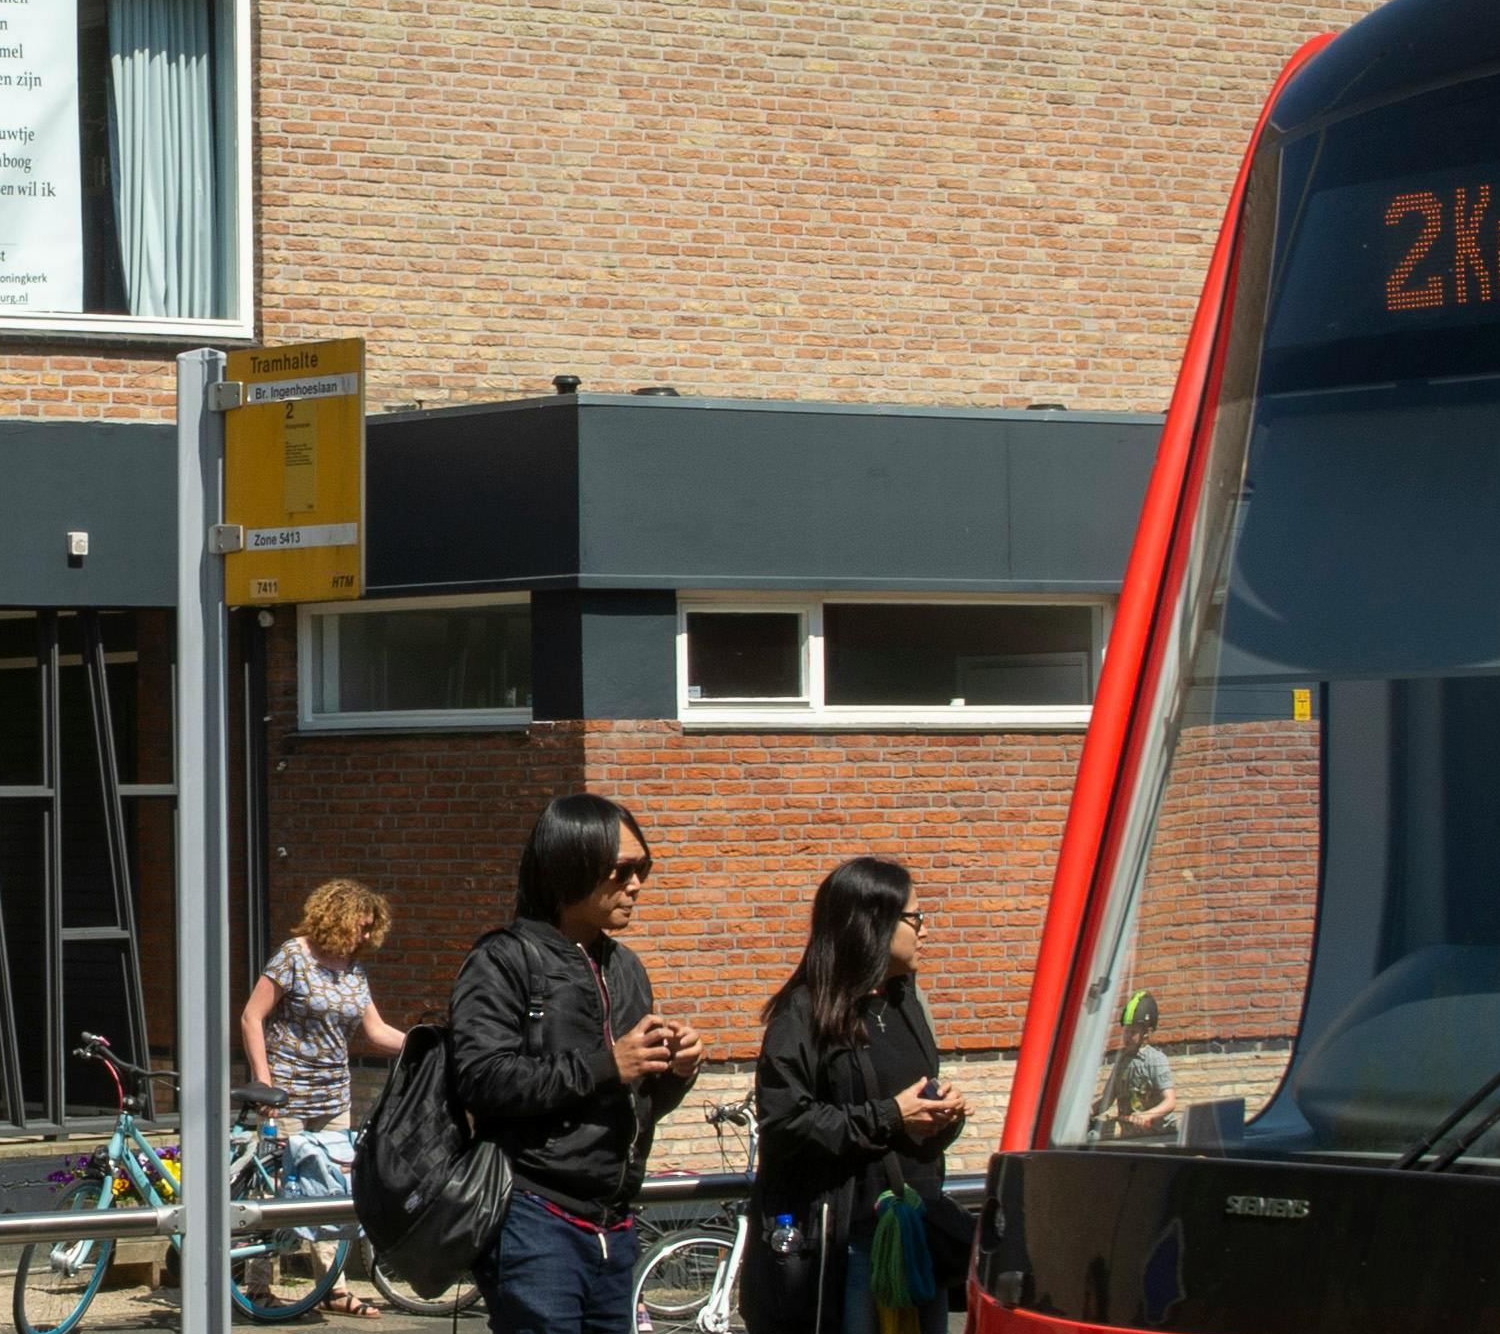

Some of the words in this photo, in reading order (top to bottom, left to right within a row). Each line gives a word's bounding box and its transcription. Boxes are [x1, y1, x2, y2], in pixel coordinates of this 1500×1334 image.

[16, 72, 42, 91] zijn
[17, 181, 36, 196] wil
[42, 182, 56, 197] ik
[250, 352, 319, 374] Tramhalte
[255, 387, 268, 400] Br.
[271, 381, 338, 398] Ingenhoeslaan
[285, 402, 294, 419] 2
[254, 534, 277, 547] Zone
[279, 531, 301, 545] 5413
[256, 581, 278, 594] 7411
[332, 575, 354, 588] HTM
